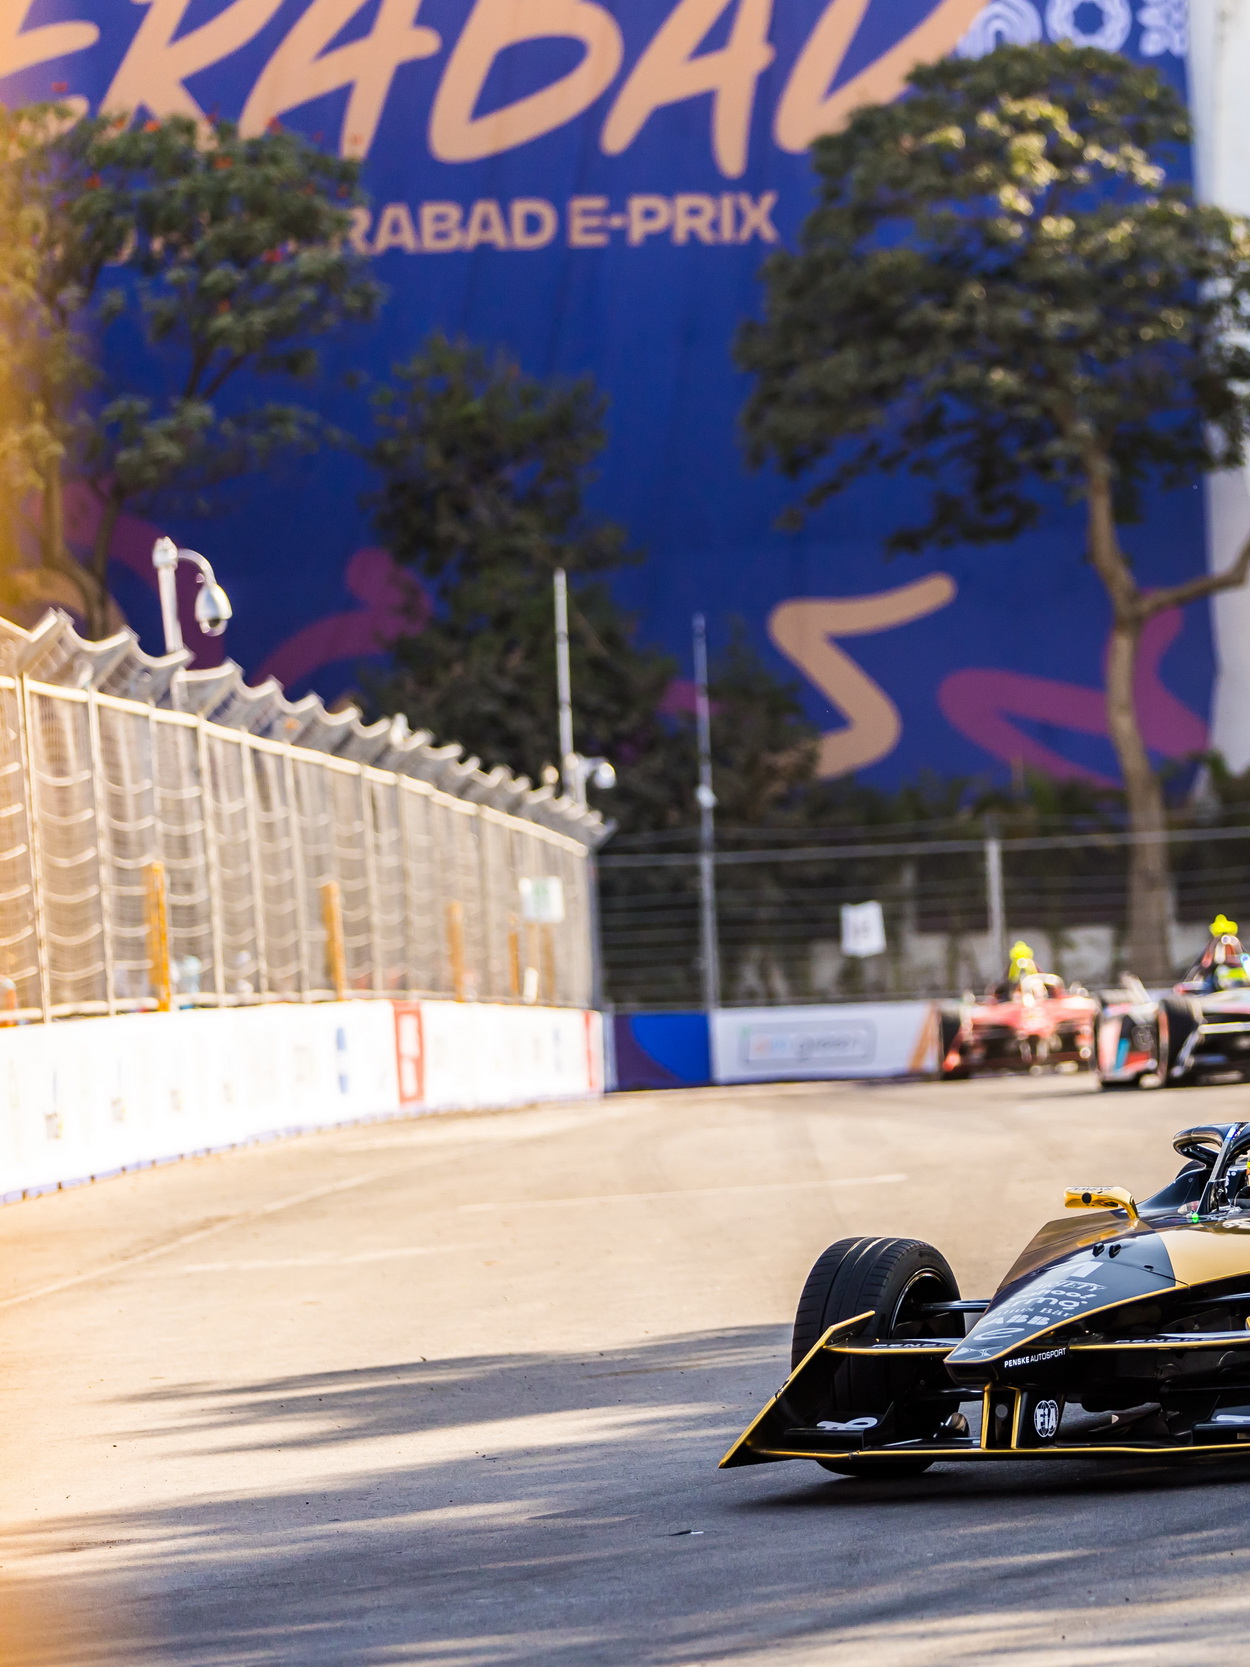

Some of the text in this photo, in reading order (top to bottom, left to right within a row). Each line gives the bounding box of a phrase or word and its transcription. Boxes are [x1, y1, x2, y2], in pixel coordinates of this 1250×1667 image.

[567, 189, 778, 248] E-PRIX
[980, 1315, 1050, 1326] ABB
[1004, 1347, 1067, 1369] PENSKE AUTOSPORT
